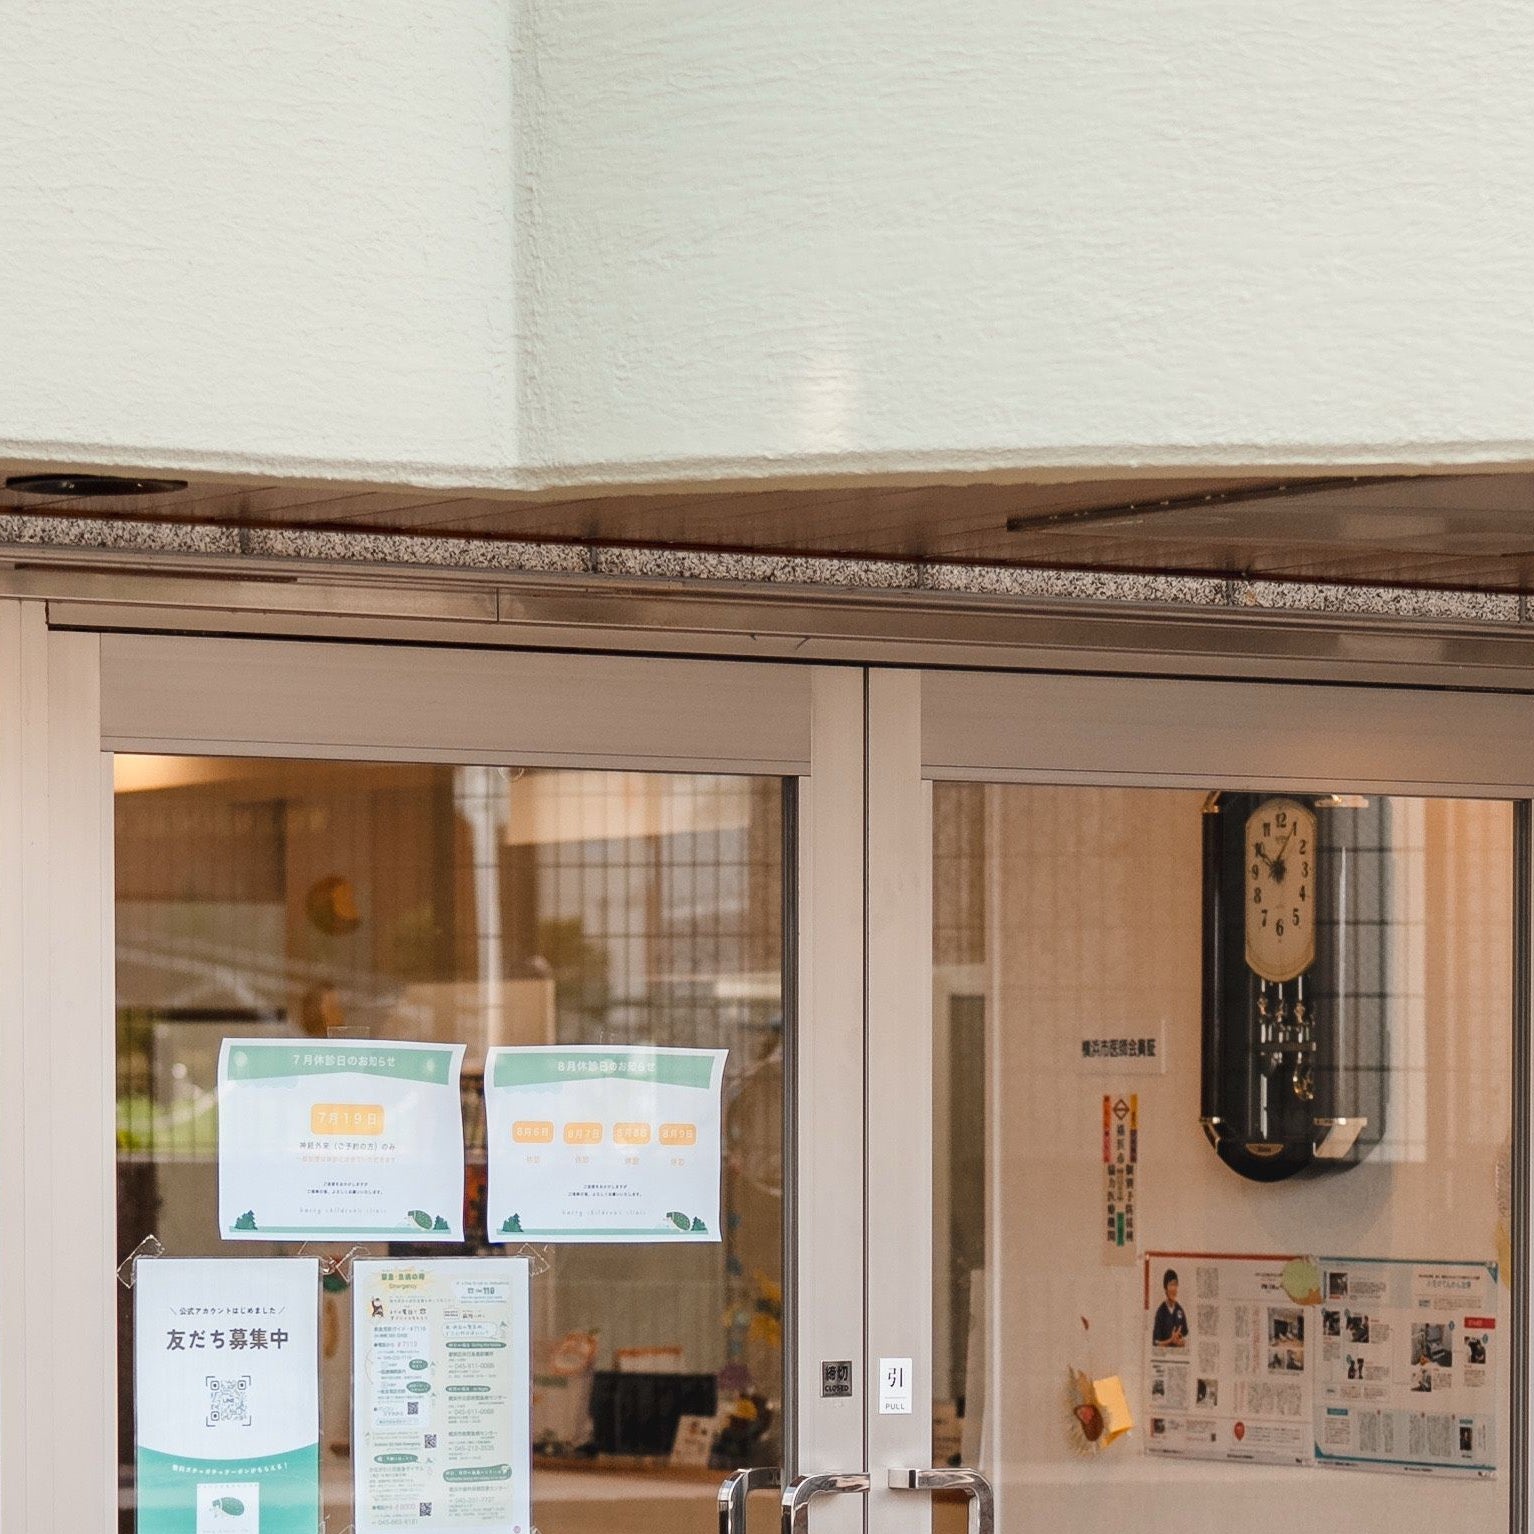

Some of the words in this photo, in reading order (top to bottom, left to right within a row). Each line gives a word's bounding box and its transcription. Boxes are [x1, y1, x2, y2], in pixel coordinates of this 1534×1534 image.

[1276, 812, 1287, 828] 12
[1263, 822, 1271, 837] 11
[1299, 840, 1306, 855] 2
[1251, 864, 1259, 880] 9
[1302, 861, 1308, 878] 3
[1254, 887, 1261, 904] 8
[1299, 885, 1306, 901] 4
[1261, 909, 1268, 927] 7
[1292, 908, 1300, 926] 5
[1276, 918, 1284, 936] 6
[293, 1054, 396, 1066] 7月休診日のお知らせ
[179, 1307, 276, 1315] 公式アカウントはじめました
[167, 1328, 288, 1351] 友だち募集中
[825, 1366, 848, 1381] 締切
[888, 1368, 903, 1388] 引
[825, 1384, 849, 1392] CLOSED
[886, 1402, 905, 1410] PULL
